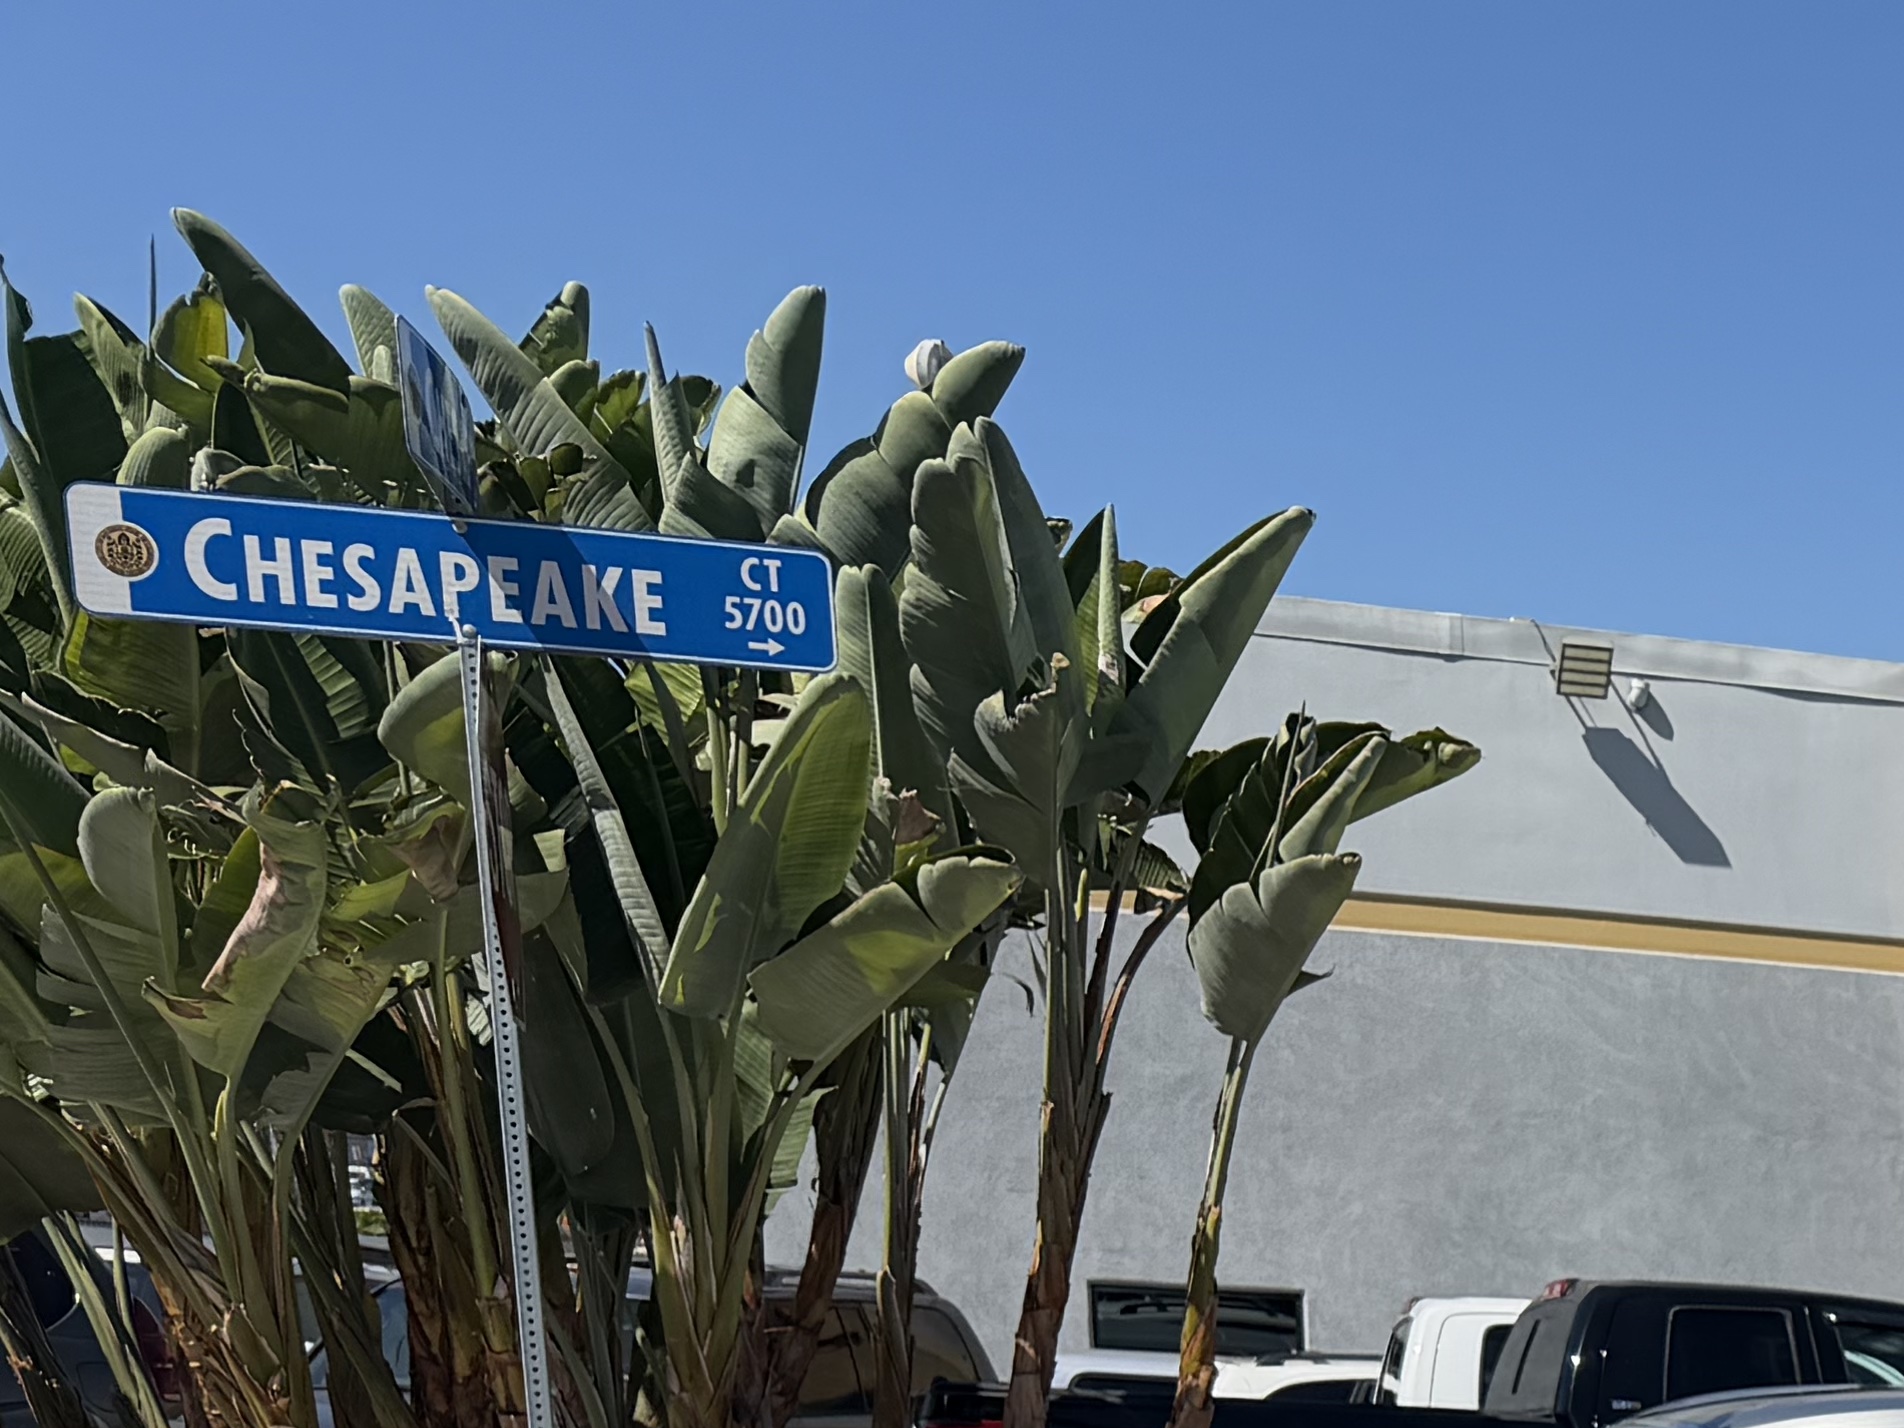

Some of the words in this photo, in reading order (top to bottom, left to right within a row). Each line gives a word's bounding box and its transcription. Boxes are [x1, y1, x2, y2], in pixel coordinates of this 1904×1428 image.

[184, 517, 667, 636] CHESAPEAKE
[739, 556, 783, 593] CT
[723, 595, 807, 635] 5700
